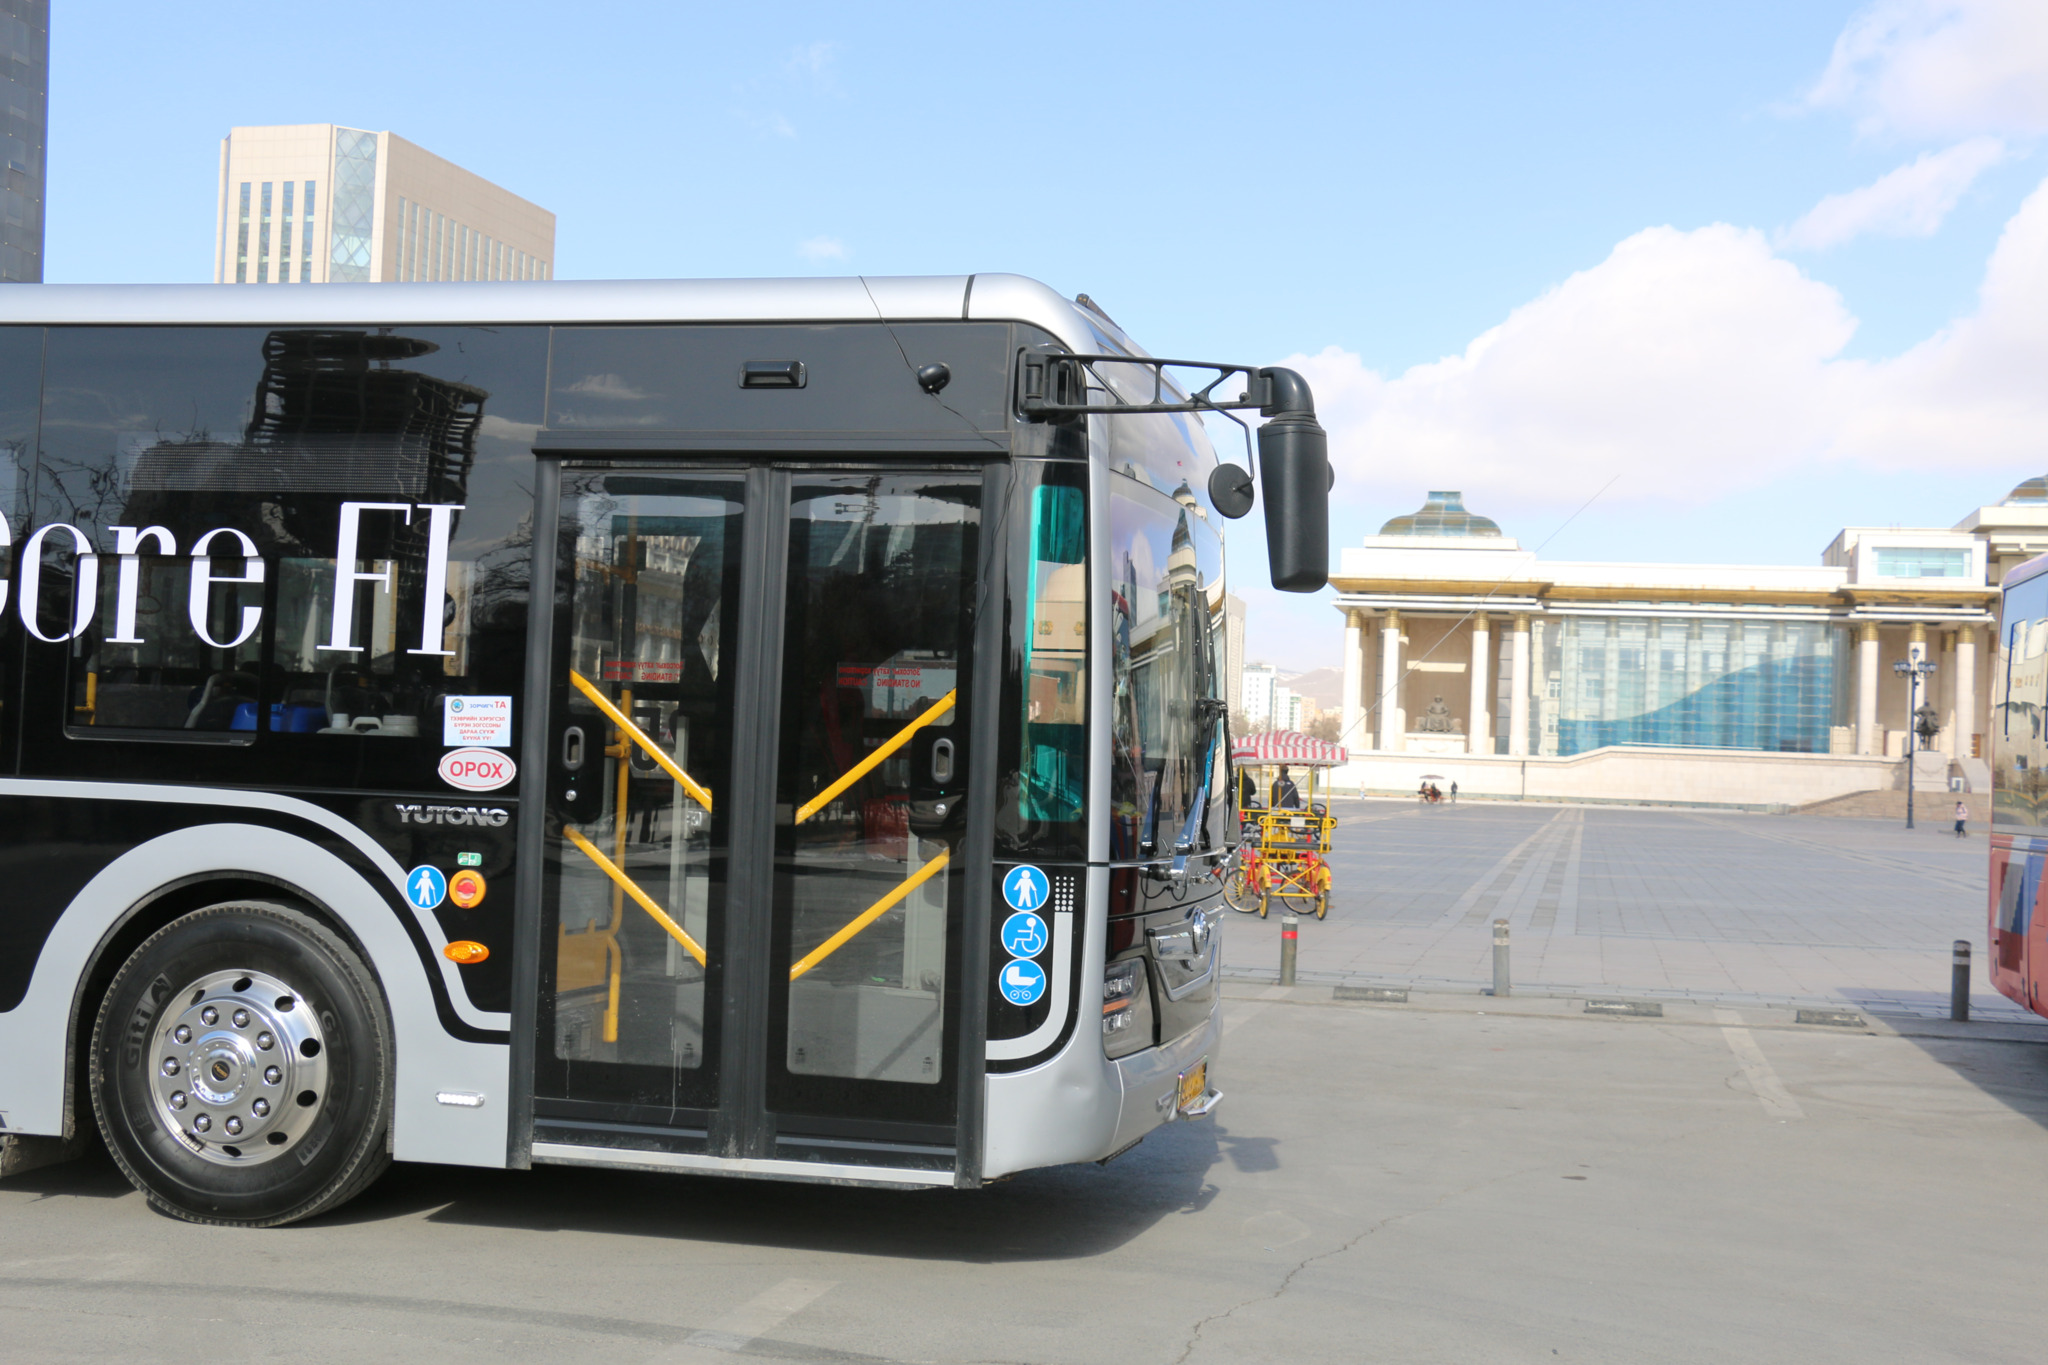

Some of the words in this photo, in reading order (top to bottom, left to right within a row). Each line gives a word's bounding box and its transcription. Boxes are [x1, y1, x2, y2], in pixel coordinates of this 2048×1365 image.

[0, 506, 265, 648] ore
[449, 760, 504, 779] ОРОХ
[395, 804, 509, 827] YUTONG
